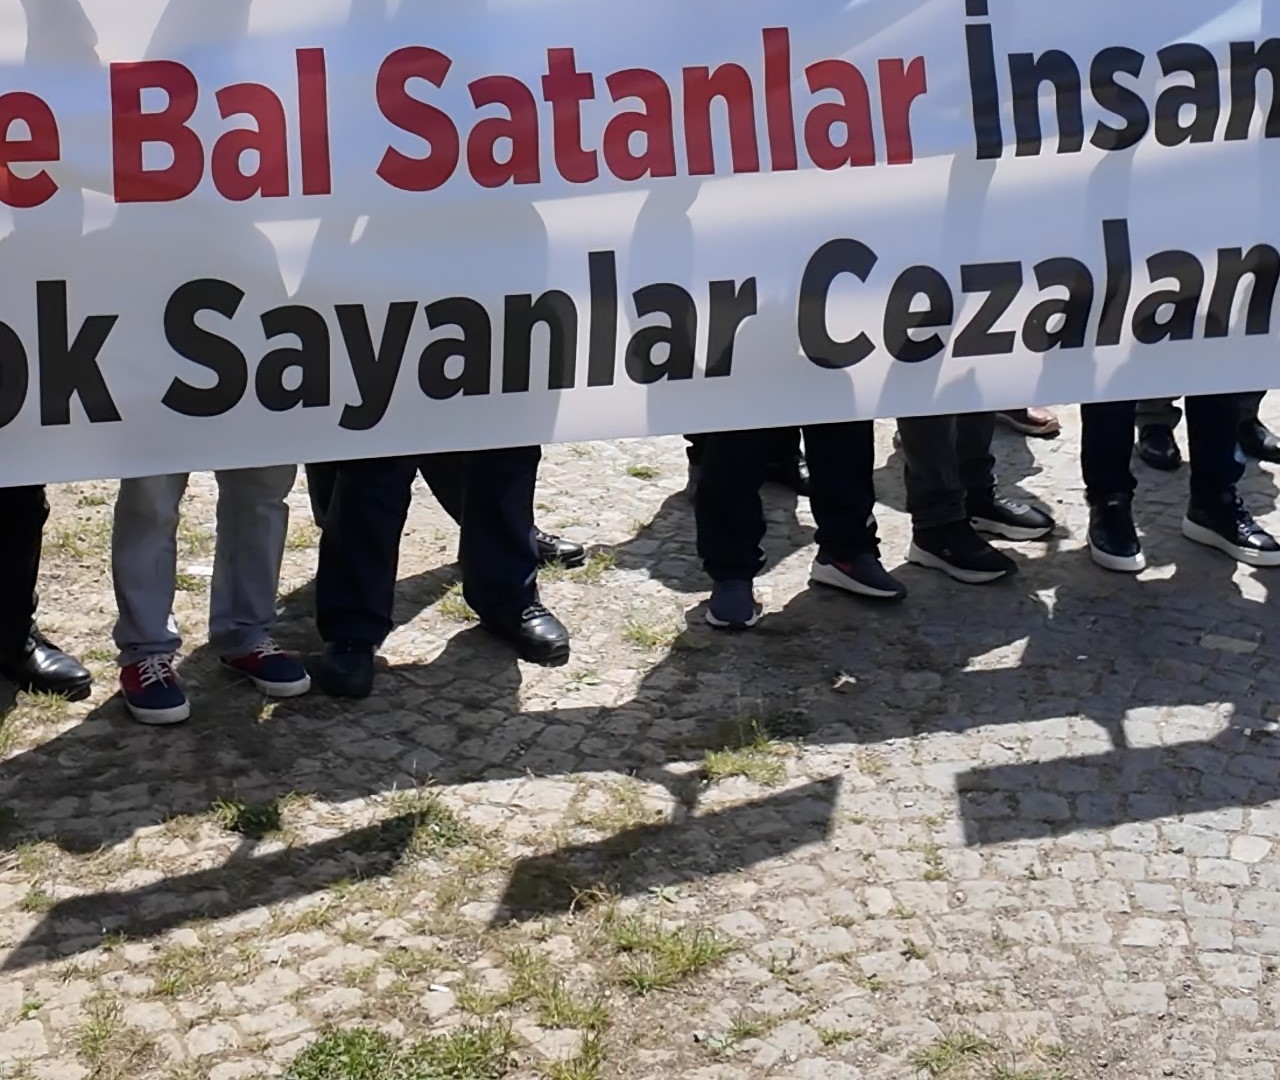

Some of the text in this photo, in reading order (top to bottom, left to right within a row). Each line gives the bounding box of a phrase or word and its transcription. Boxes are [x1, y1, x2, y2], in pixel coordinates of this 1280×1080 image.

[110, 48, 332, 203] Bal
[375, 27, 928, 192] Satanlar
[160, 250, 758, 432] Sayanlar
